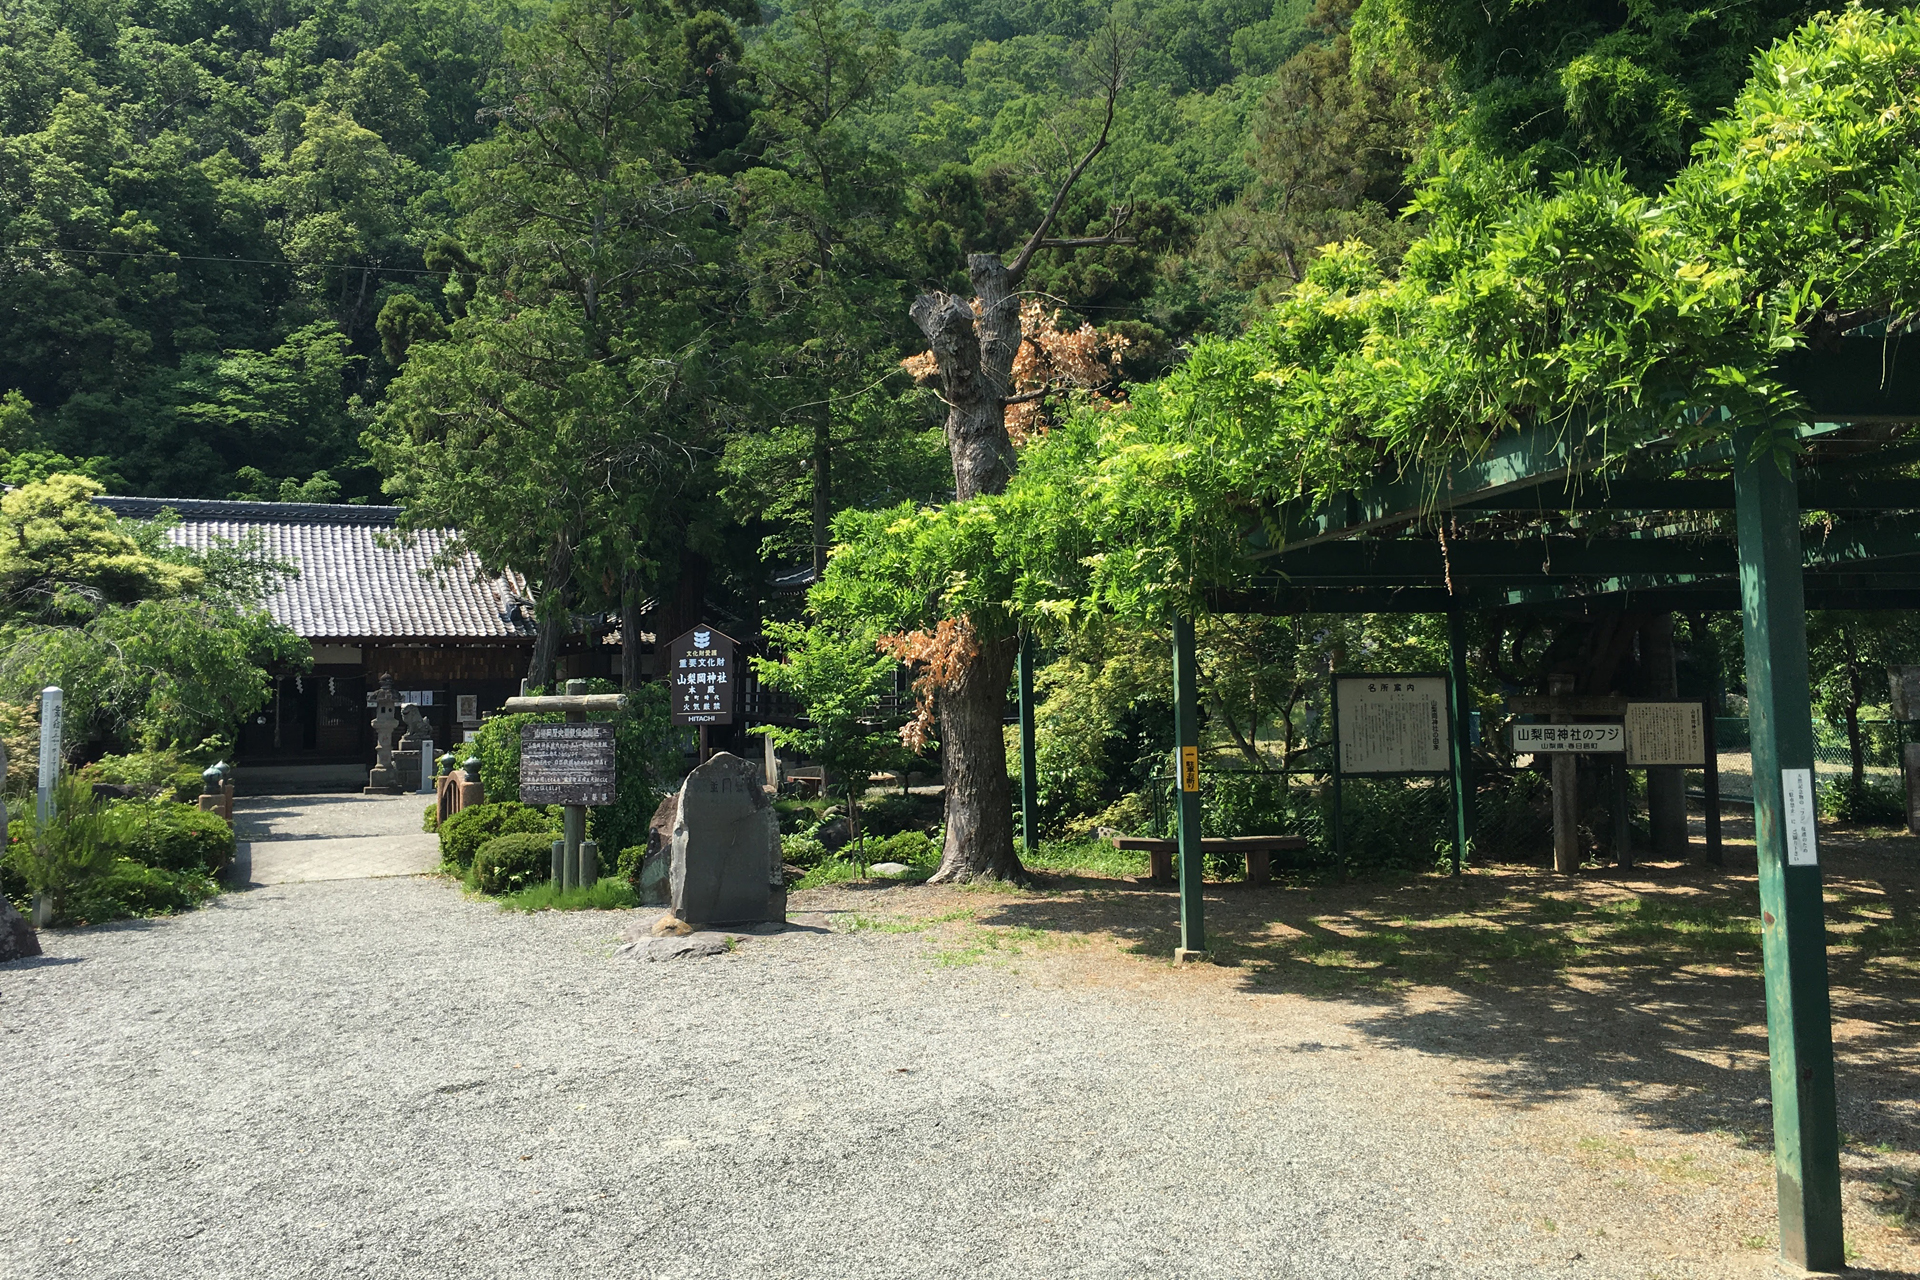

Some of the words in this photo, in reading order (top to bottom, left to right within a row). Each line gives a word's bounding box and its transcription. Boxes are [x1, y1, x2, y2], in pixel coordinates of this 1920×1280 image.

[678, 658, 726, 668] 重要文化財
[676, 671, 728, 685] 山梨岡神社
[687, 685, 715, 695] 本殿
[1368, 683, 1415, 693] 名所案内
[683, 702, 721, 711] 火気厳禁
[1517, 728, 1619, 741] 山梨岡神社のフジ
